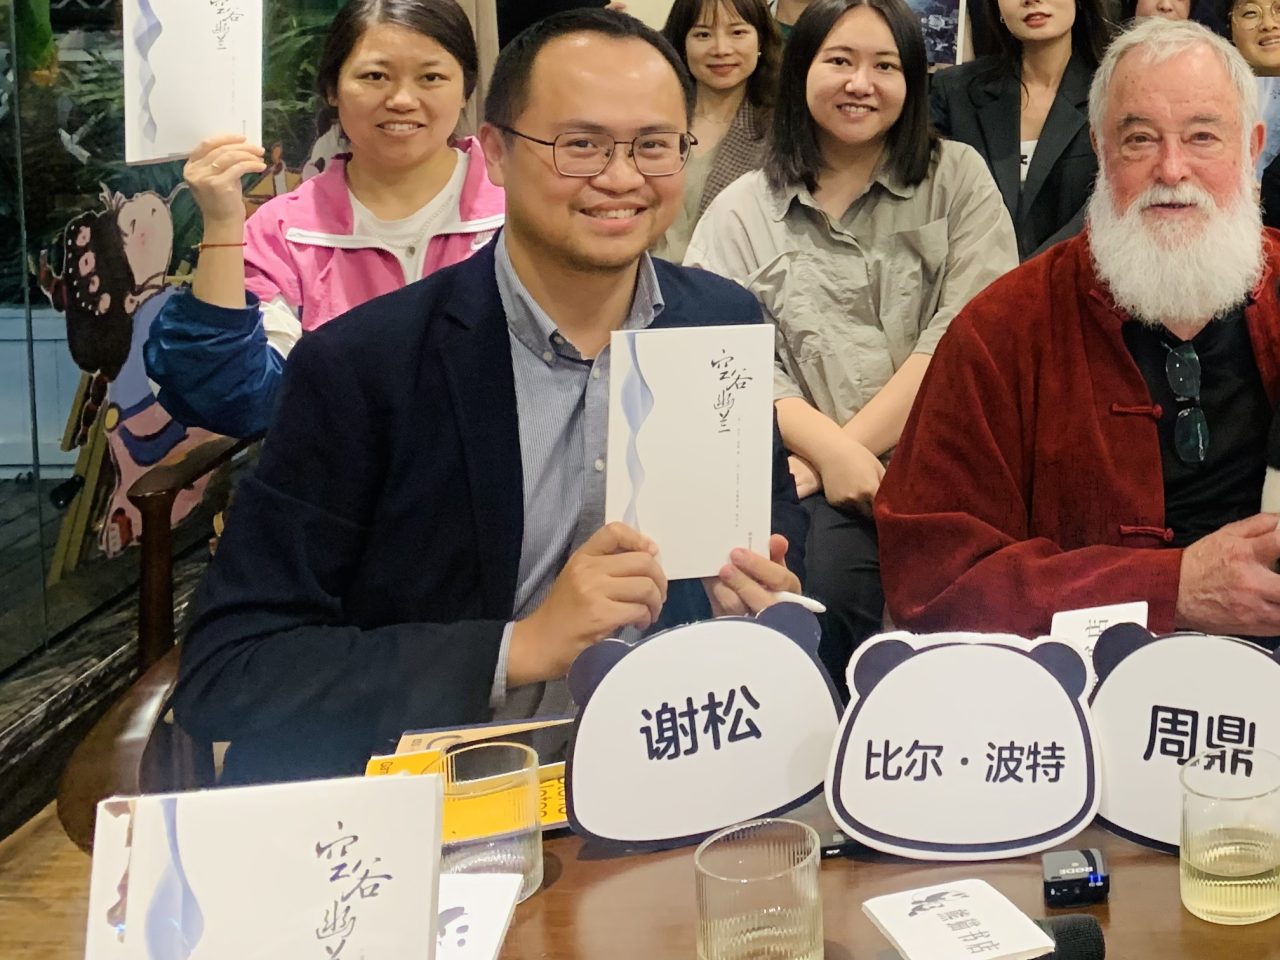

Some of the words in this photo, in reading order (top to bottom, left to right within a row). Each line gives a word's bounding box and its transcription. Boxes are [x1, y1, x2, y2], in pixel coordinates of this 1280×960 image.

[710, 348, 753, 434] 空谷幽兰
[639, 685, 763, 761] 谢松
[1143, 705, 1256, 777] 周鼎
